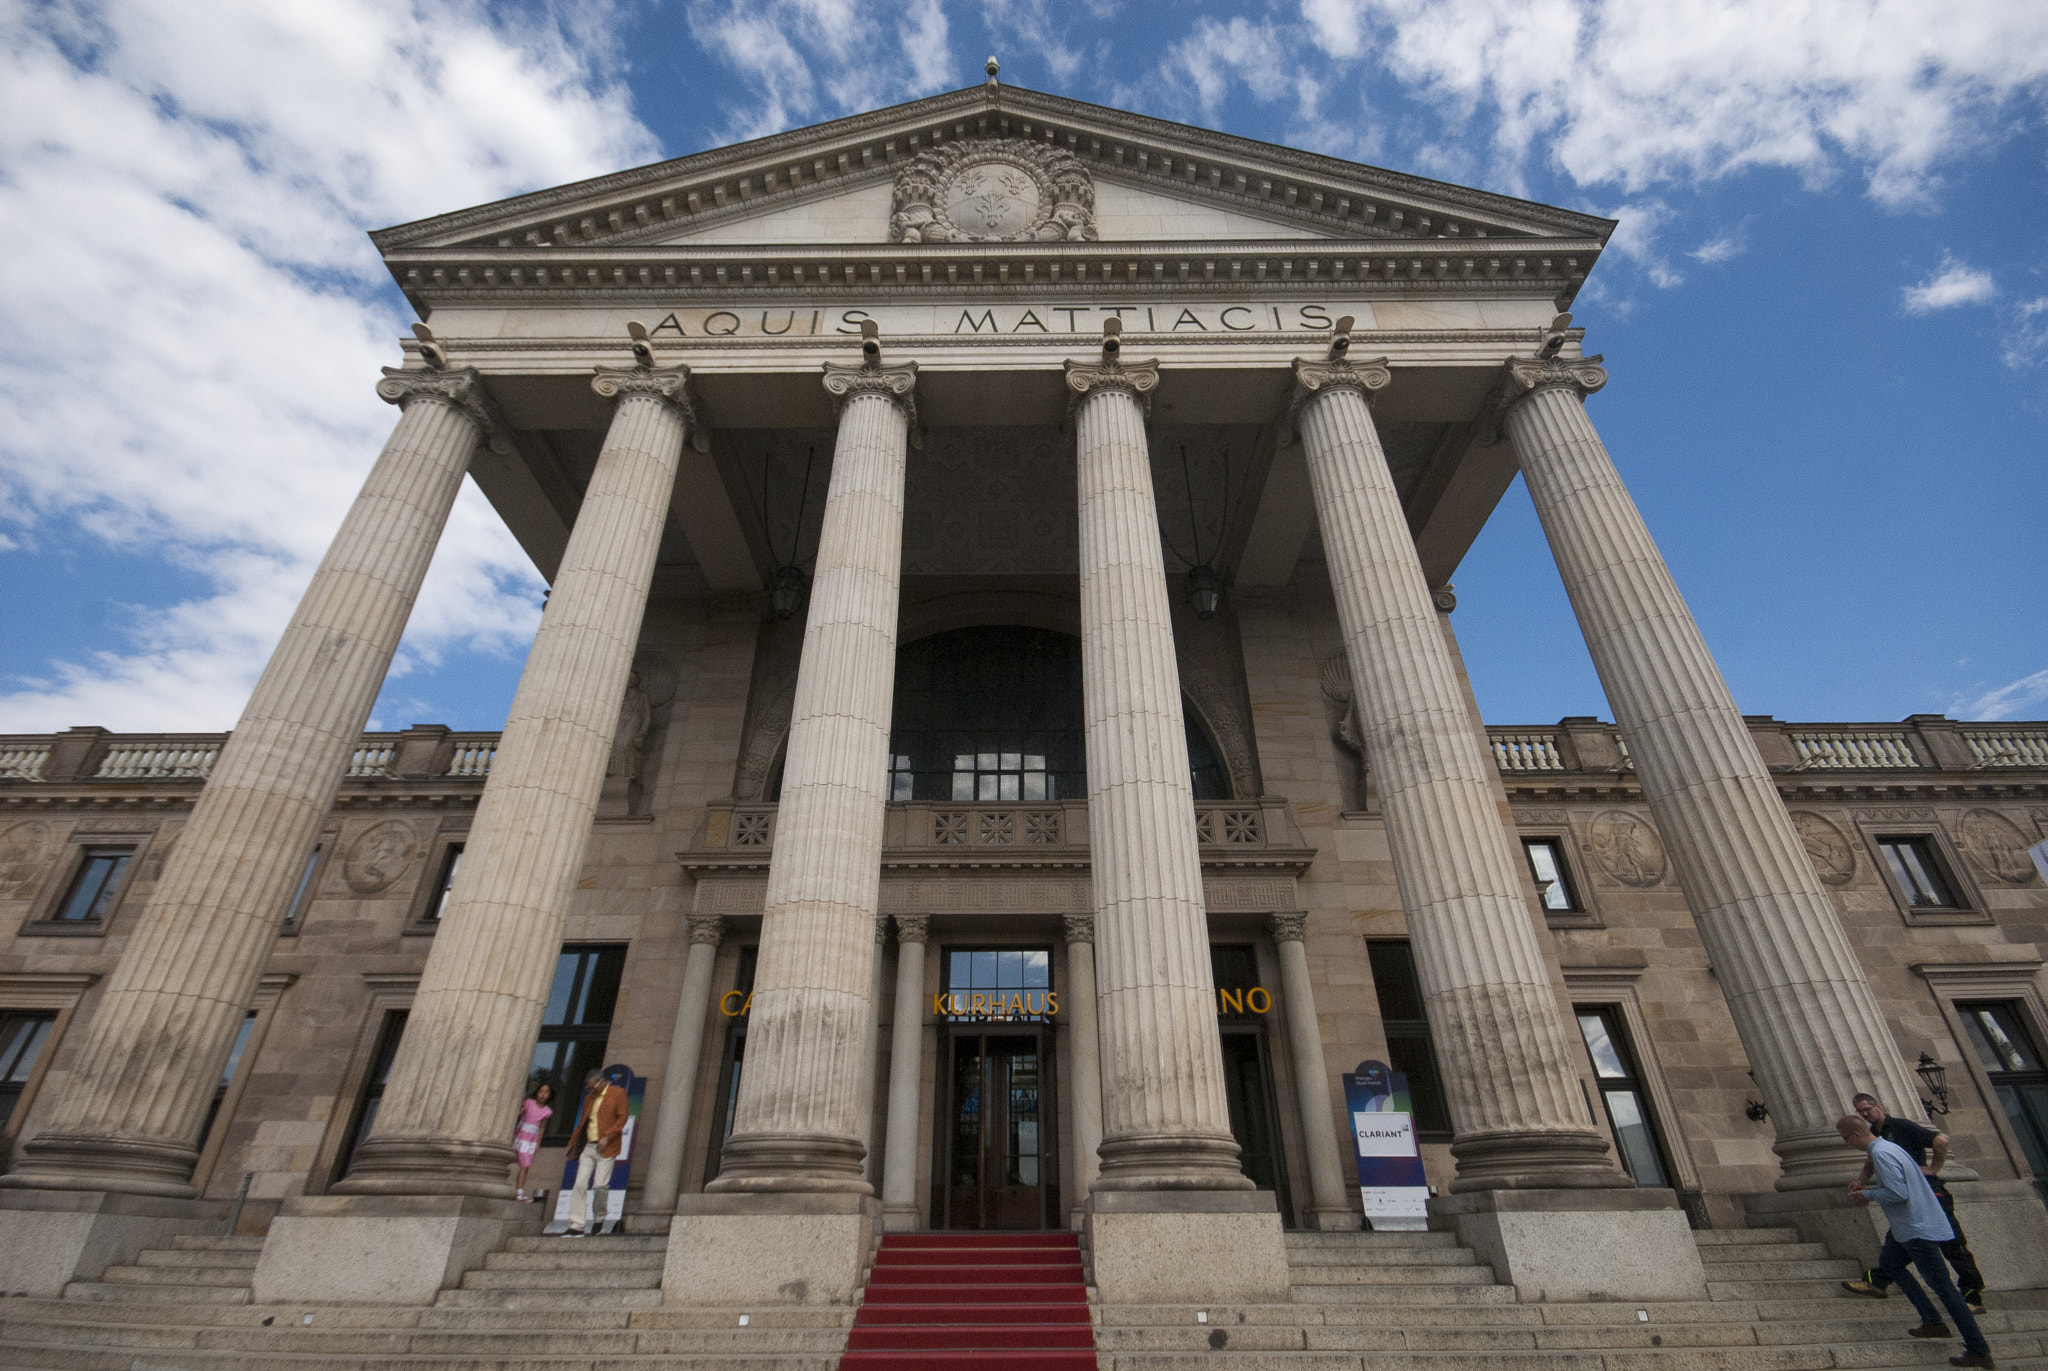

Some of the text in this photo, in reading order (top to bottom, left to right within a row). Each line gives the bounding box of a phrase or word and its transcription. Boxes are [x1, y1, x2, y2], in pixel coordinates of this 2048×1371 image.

[649, 305, 1333, 336] AQUIS MATTIACIS
[933, 991, 1059, 1016] KURHAUS
[1359, 1130, 1402, 1138] CLARIANT
